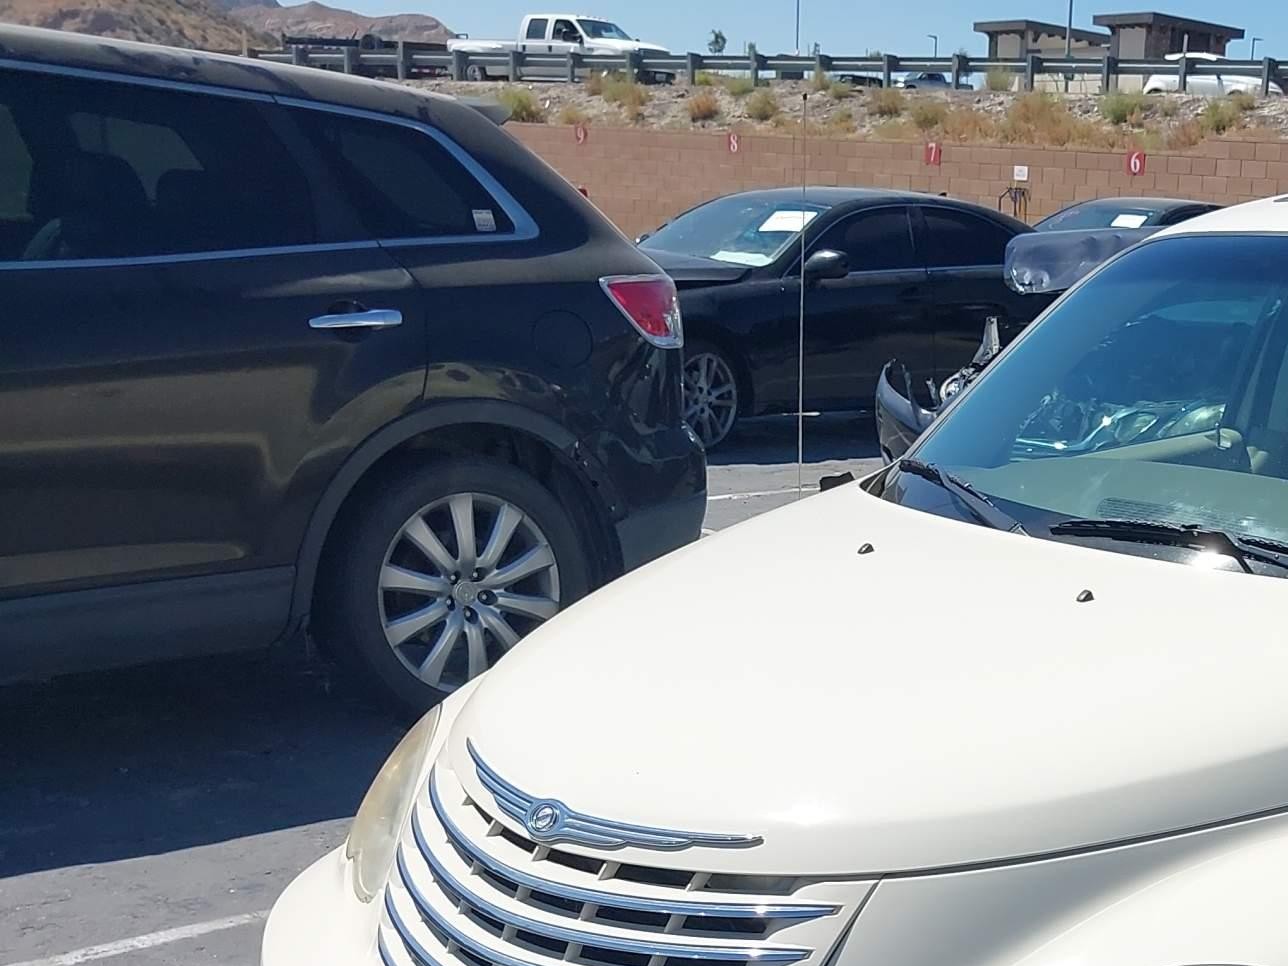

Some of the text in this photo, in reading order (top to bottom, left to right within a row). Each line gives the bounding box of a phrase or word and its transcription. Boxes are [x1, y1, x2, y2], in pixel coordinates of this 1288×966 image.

[729, 133, 738, 152] 8
[928, 142, 936, 162] 7
[1130, 151, 1140, 173] 6
